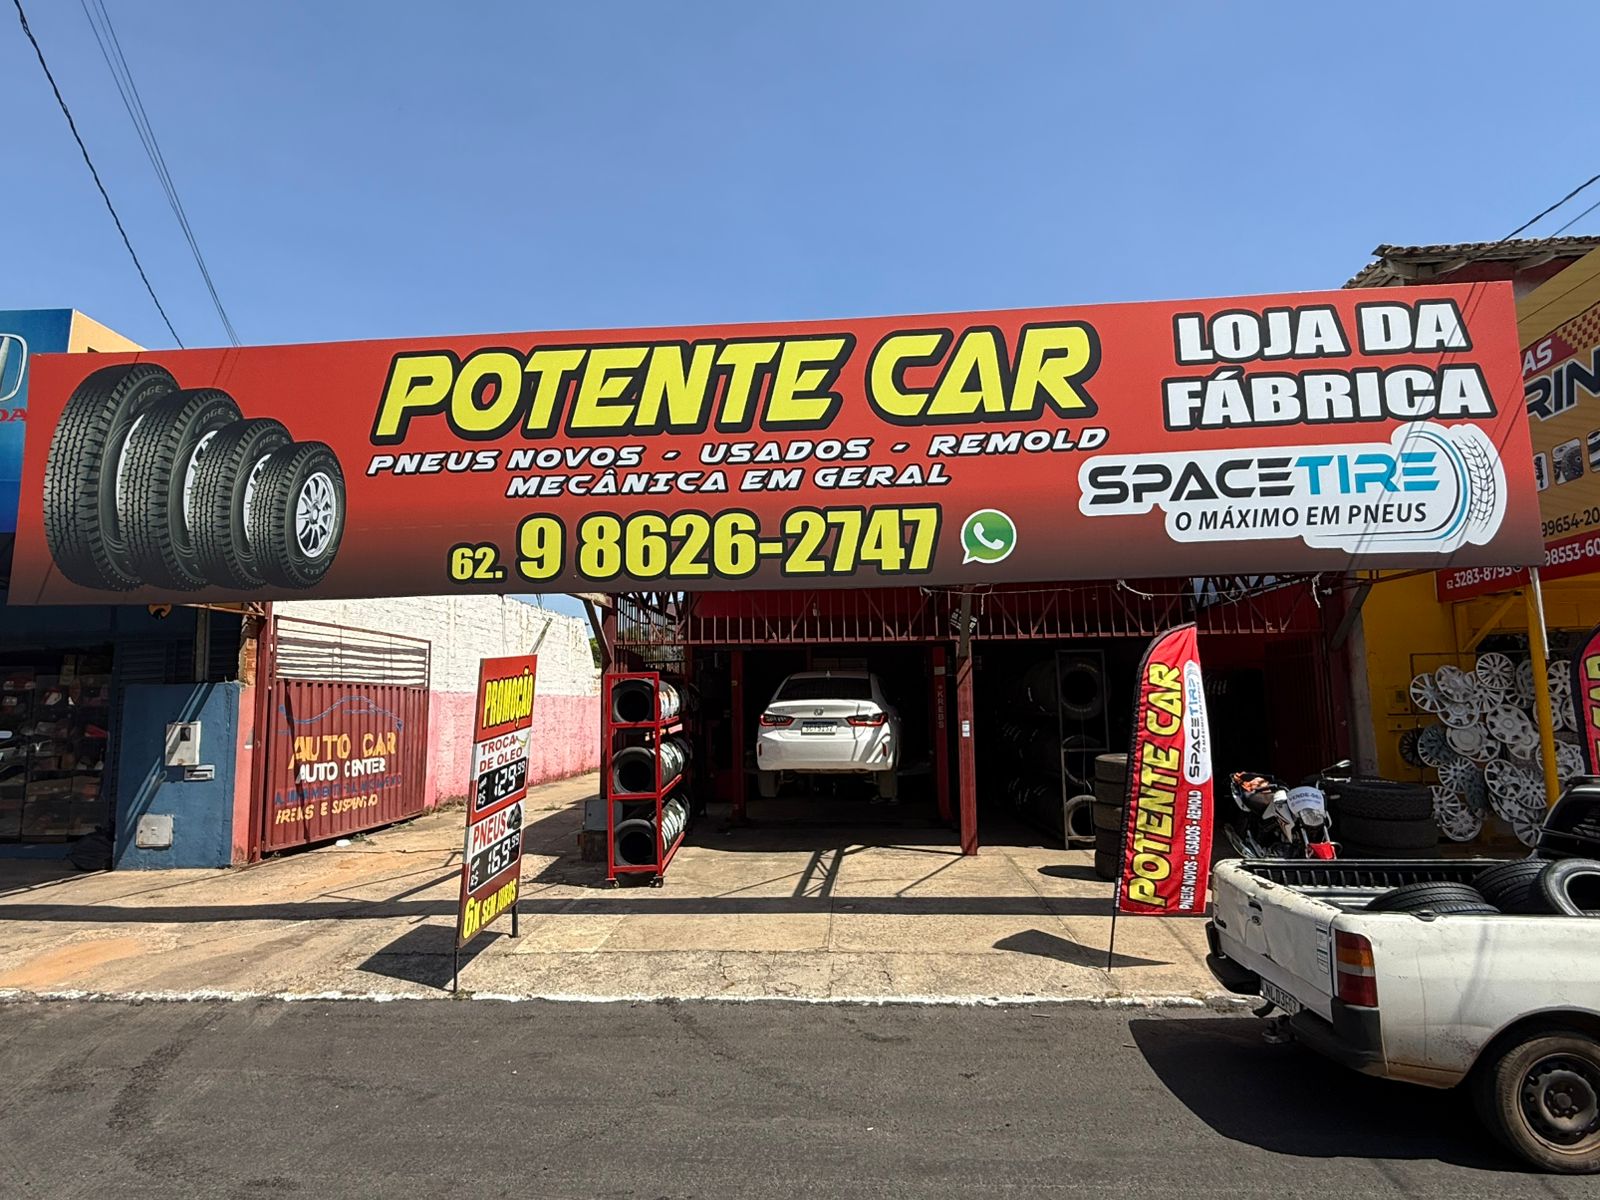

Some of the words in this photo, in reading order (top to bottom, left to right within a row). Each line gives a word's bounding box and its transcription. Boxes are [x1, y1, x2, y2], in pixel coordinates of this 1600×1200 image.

[1175, 306, 1349, 363] LOJA
[1357, 300, 1470, 353] DA
[373, 336, 850, 440] POTENTE
[868, 323, 1094, 420] CAR
[1163, 367, 1495, 430] FÁBRICA
[366, 450, 500, 475] PNEUS
[506, 445, 645, 470] NOVOS
[663, 451, 681, 459] -
[699, 438, 872, 464] USADOS
[892, 443, 911, 451] -
[928, 427, 1108, 457] REMOLD
[506, 468, 727, 497] MECÂNICA
[739, 468, 804, 492] EM
[814, 463, 951, 489] GERAL
[1087, 451, 1441, 505] SPACETIRE
[1174, 511, 1193, 532] O
[1198, 504, 1300, 531] MÁXIMO
[1305, 505, 1341, 526] EM
[1348, 502, 1427, 525] PNEUS
[450, 545, 504, 581] 62.
[518, 514, 563, 579] 9
[578, 506, 940, 579] 8626-2747
[482, 666, 534, 729] PROMOÇÃO
[1146, 662, 1182, 737] CAR
[288, 733, 352, 770] AUTO
[363, 731, 398, 758] CAR
[479, 757, 494, 773] DE
[481, 734, 517, 756] TROCA
[295, 762, 339, 784] AUTO
[344, 757, 386, 778] CENTER
[1128, 741, 1181, 909] POTENTE
[1186, 790, 1202, 820] REMOLD
[472, 810, 508, 855] PNEUS
[1184, 824, 1202, 855] USADOS
[1181, 860, 1198, 886] NOVOS
[1179, 886, 1195, 910] PNEUS
